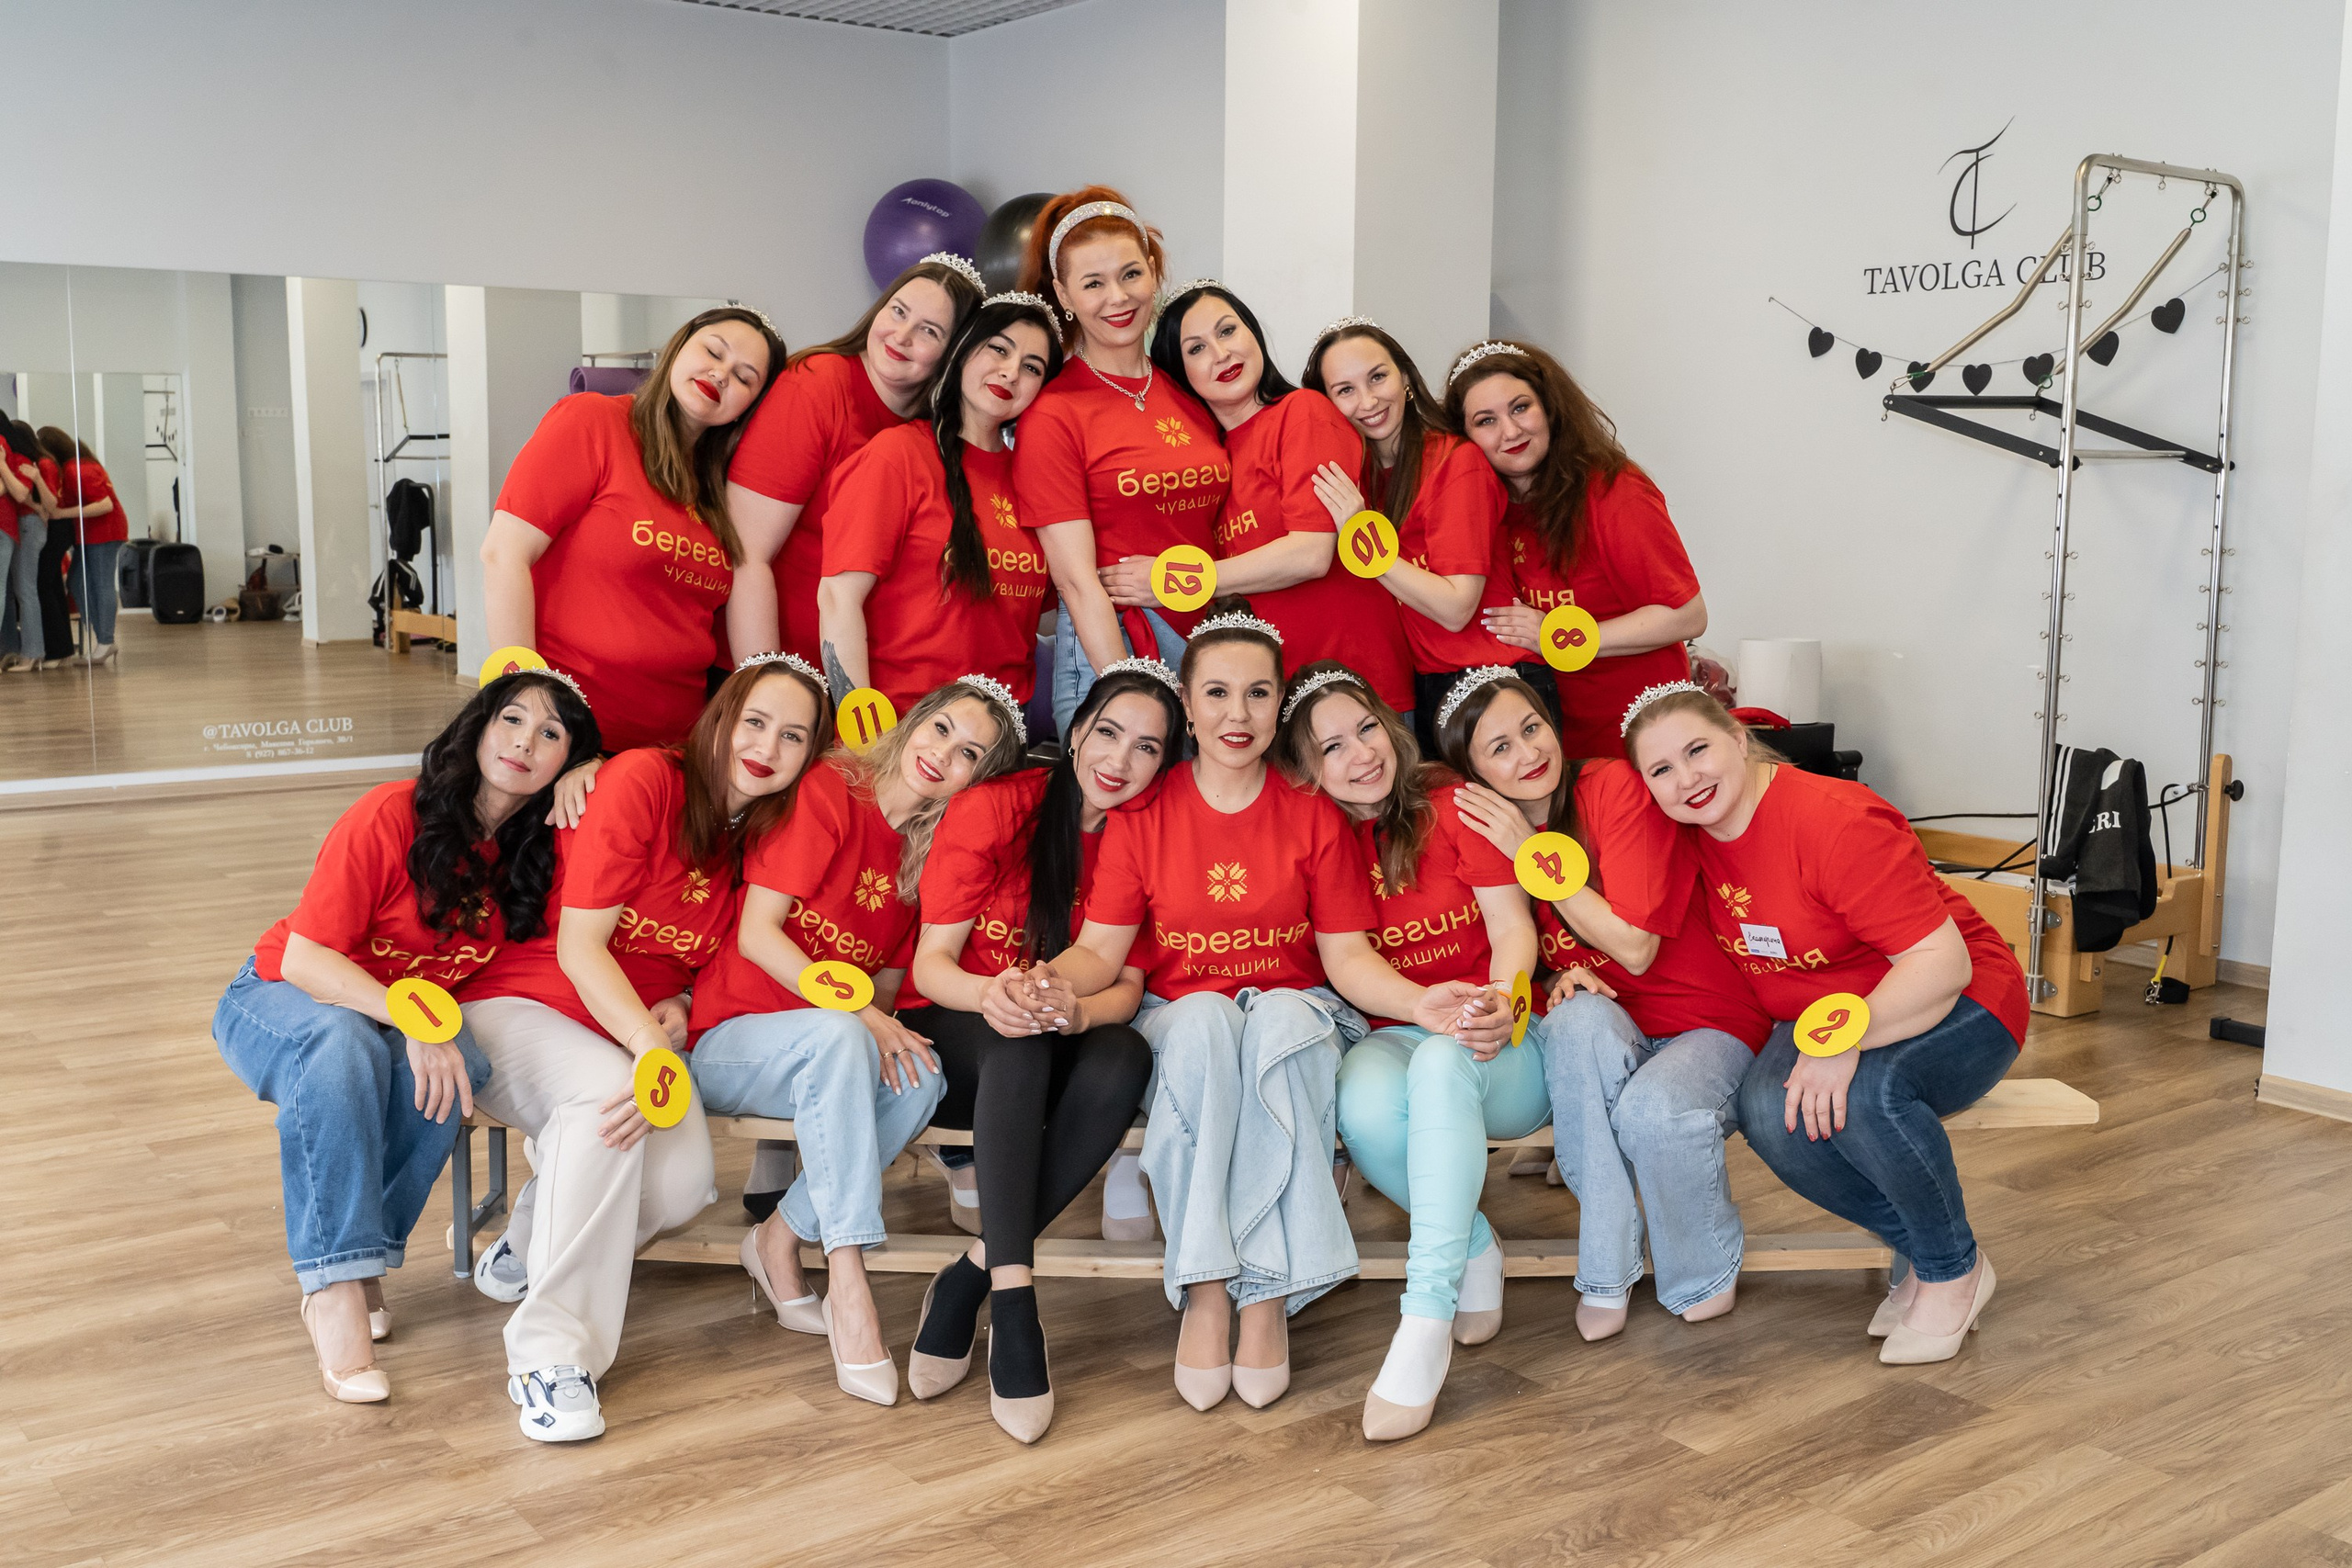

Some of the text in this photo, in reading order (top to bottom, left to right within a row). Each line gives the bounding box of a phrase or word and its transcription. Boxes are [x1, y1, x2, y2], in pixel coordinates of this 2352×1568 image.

[1863, 259, 2006, 295] TAVOLGA
[1163, 561, 1204, 596] 12
[1551, 627, 1588, 650] 8
[202, 716, 354, 739] @TAVOLGA CLUB
[851, 701, 883, 745] 11
[1155, 921, 1309, 959] берегиня
[1182, 957, 1280, 977] чувашии
[407, 991, 443, 1028] 1
[1807, 1009, 1851, 1045] 2
[650, 1066, 677, 1108] 5
